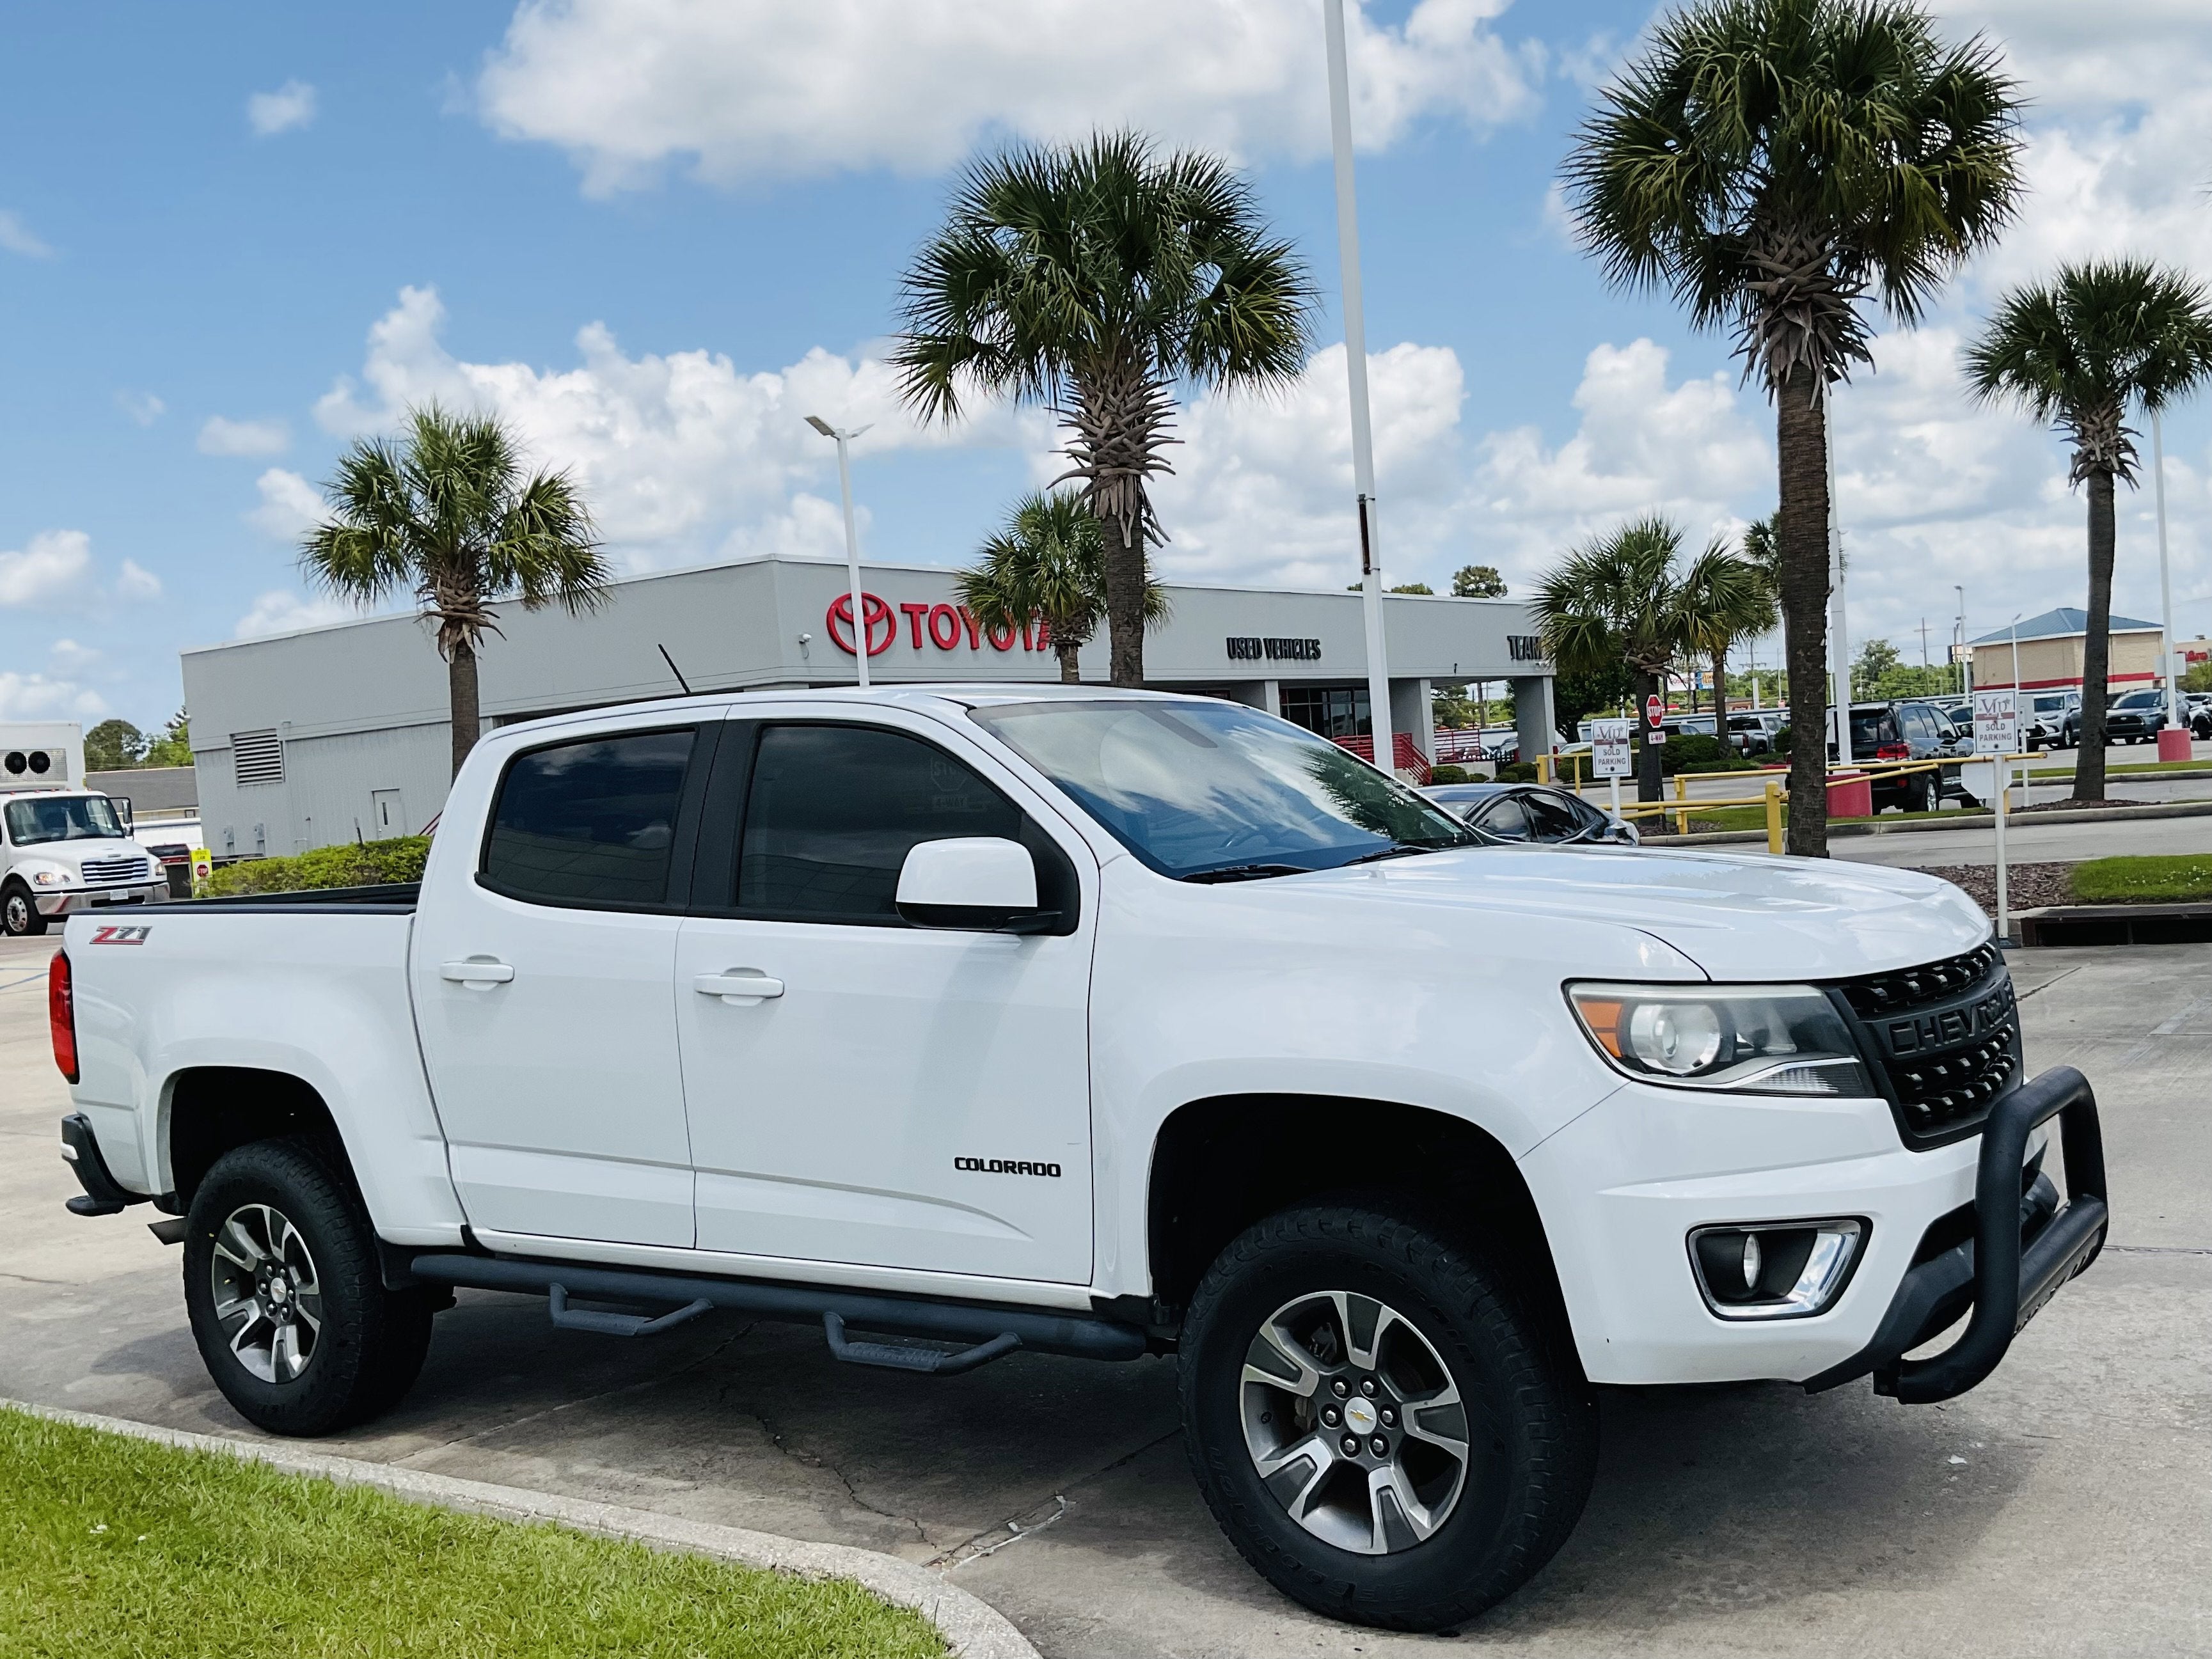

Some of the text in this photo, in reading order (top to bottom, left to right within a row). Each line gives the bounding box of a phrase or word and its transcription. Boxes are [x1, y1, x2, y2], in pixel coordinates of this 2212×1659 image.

[1226, 637, 1322, 660] USED VEHICLES
[1648, 705, 1661, 718] STOP
[1986, 723, 2005, 731] SOLD
[1979, 733, 2012, 741] PARKING
[1598, 757, 1626, 766] PARKING
[89, 925, 153, 945] Z71
[954, 1156, 1062, 1177] COLORADO
